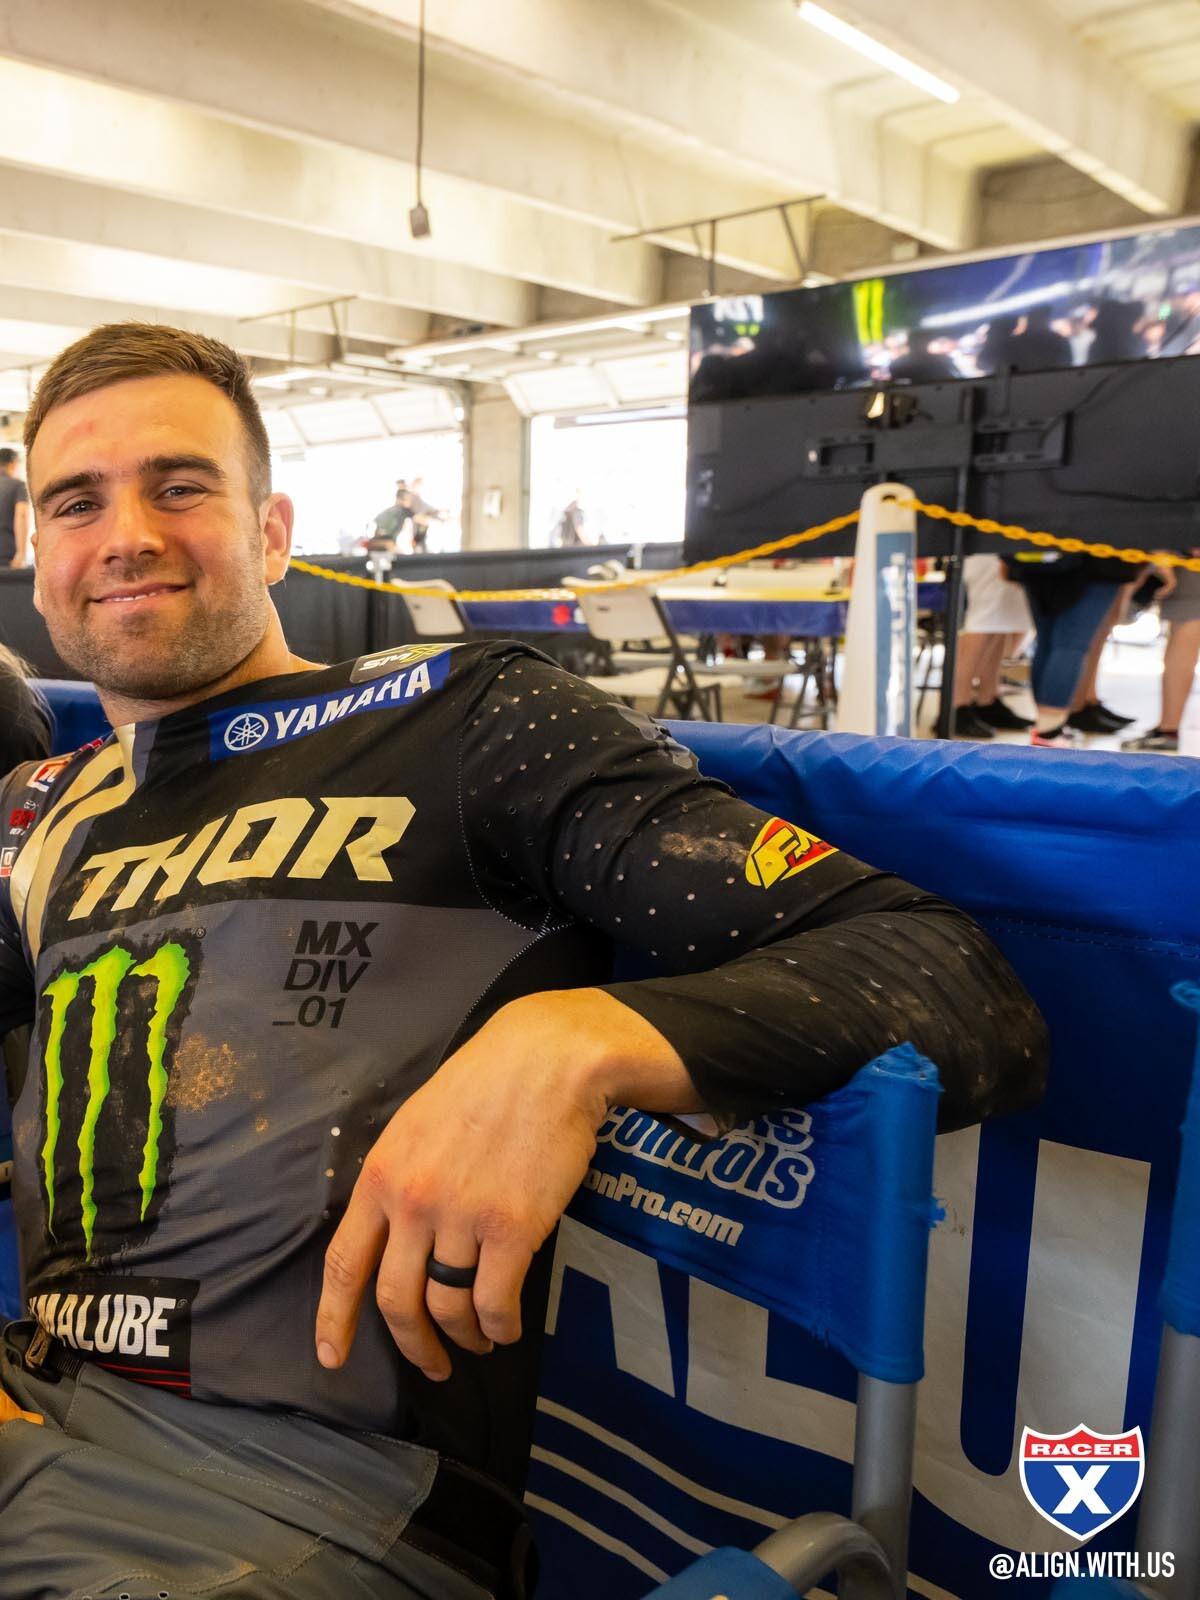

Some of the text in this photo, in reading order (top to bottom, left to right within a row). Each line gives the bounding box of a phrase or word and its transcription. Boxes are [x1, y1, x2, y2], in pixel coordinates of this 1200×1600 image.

[273, 662, 432, 740] YAMAHA
[67, 796, 416, 922] THOR
[283, 958, 371, 993] DIV
[295, 920, 379, 957] MX
[582, 1168, 744, 1247] onPro.com
